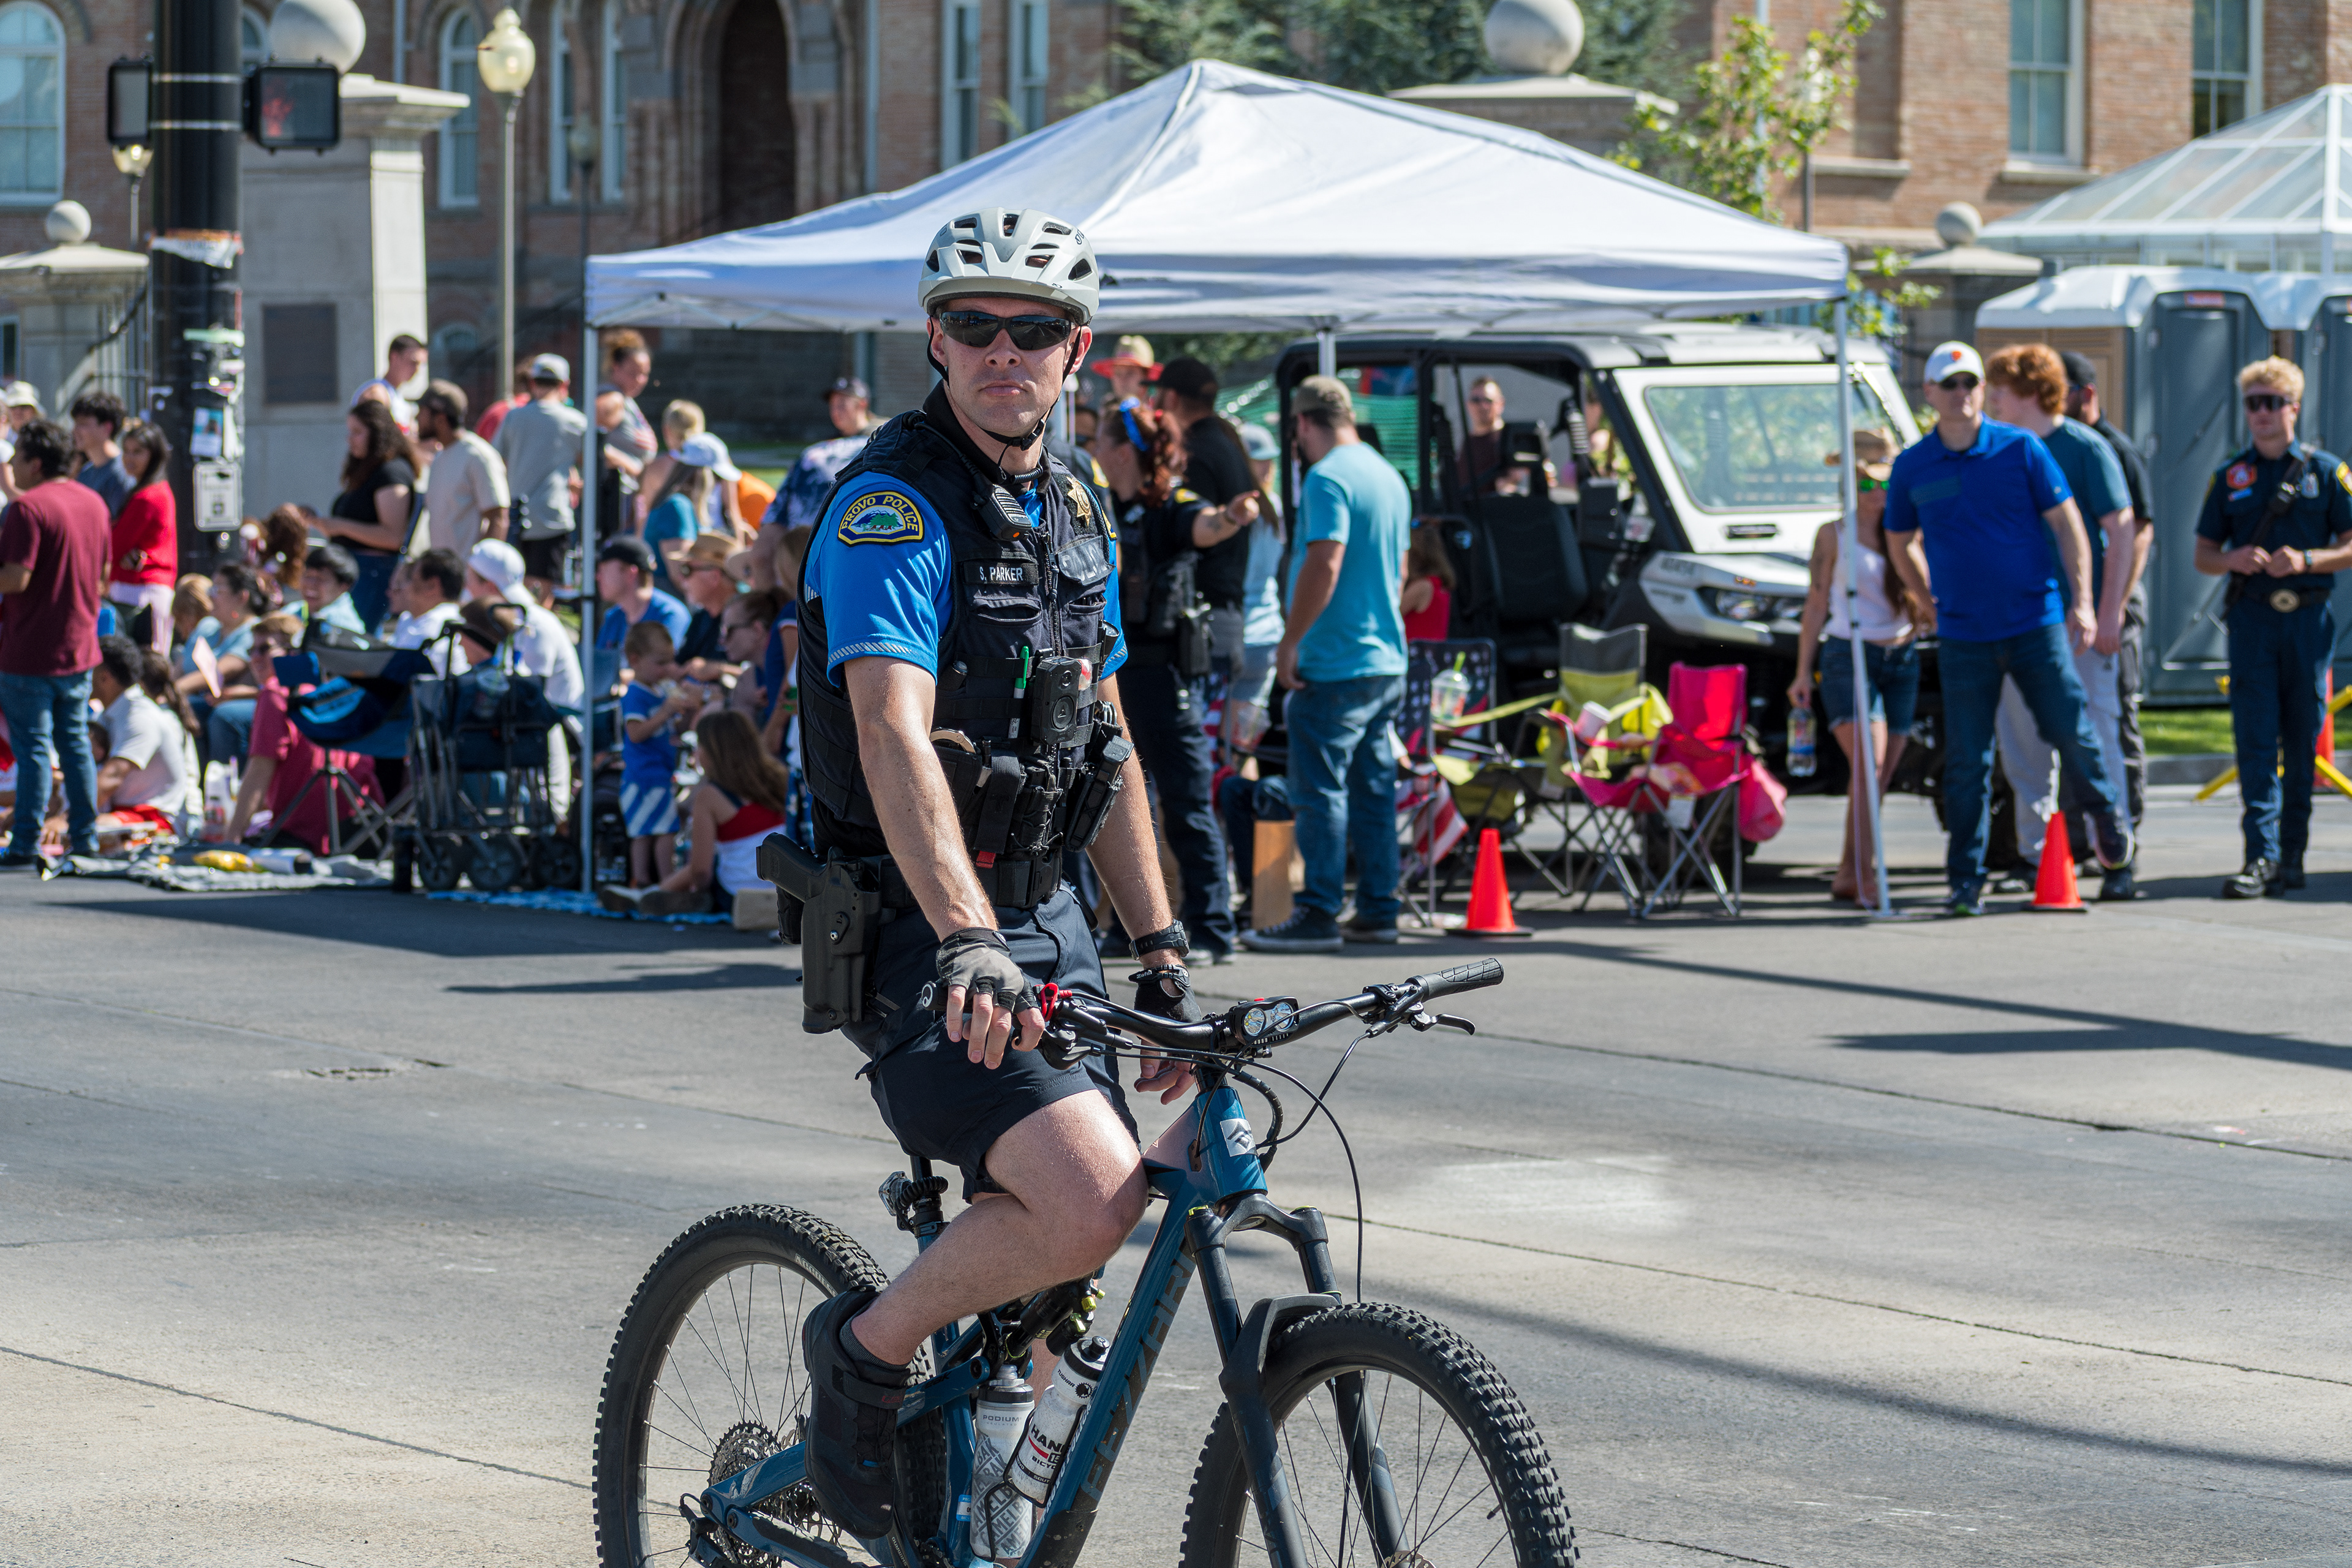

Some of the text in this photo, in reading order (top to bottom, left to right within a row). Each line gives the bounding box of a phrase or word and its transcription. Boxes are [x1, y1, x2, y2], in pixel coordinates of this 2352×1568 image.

[841, 495, 918, 532] PROVO POLICE
[979, 567, 1023, 581] S. PARKER
[1057, 1368, 1076, 1389] TUSHAR
[1080, 1254, 1197, 1501] FEZZARI
